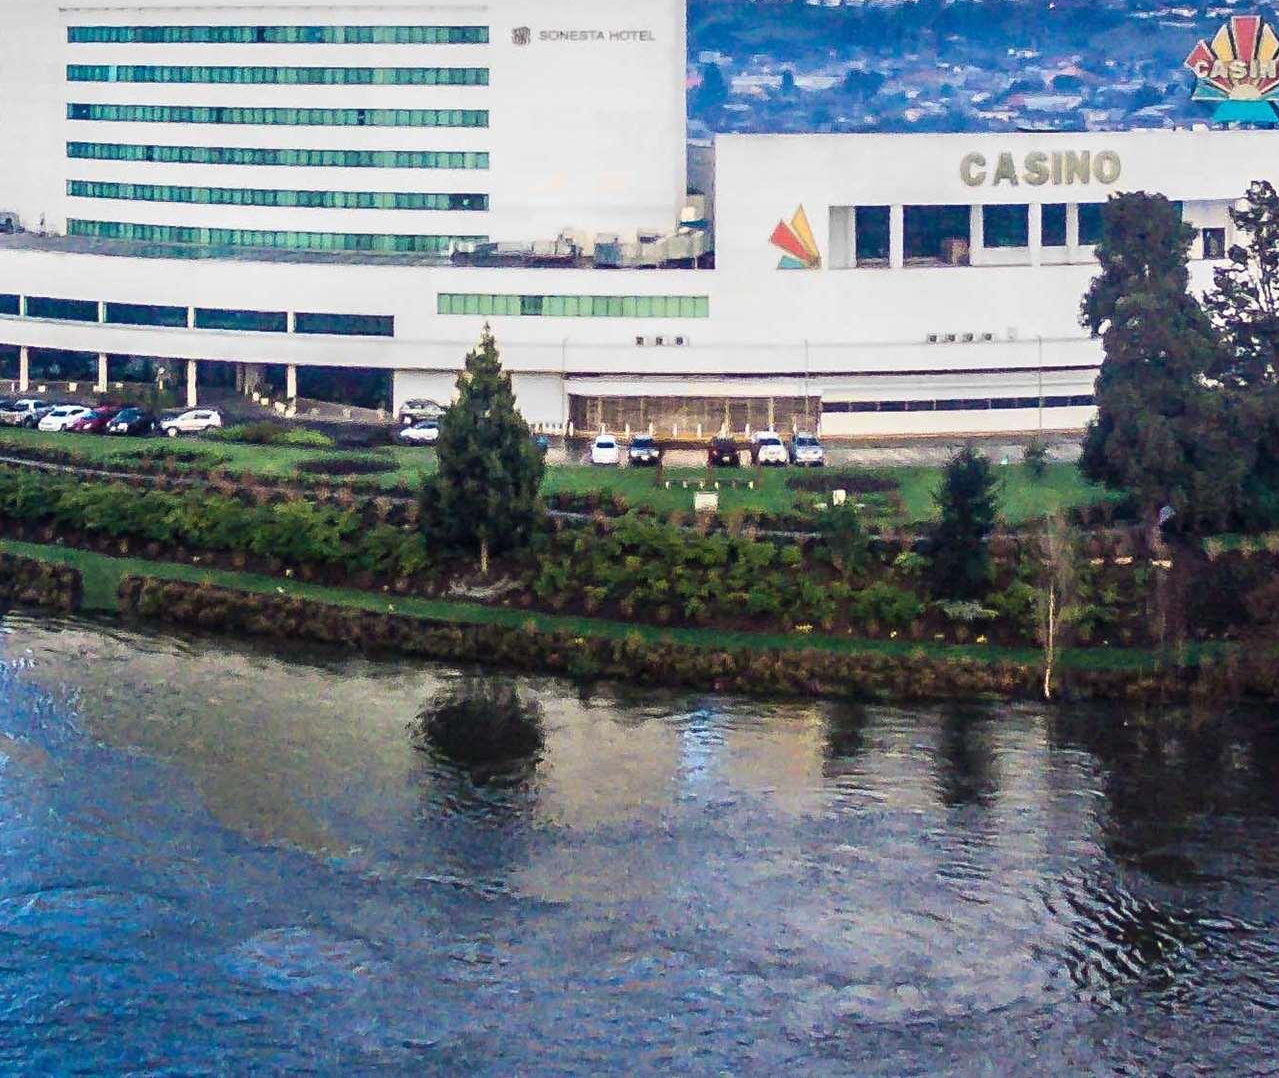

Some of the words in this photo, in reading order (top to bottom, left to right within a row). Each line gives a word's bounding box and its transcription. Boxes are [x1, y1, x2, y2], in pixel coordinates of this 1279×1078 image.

[538, 30, 605, 42] SONESTA
[608, 30, 656, 42] HOTEL
[960, 150, 1121, 186] CASINO
